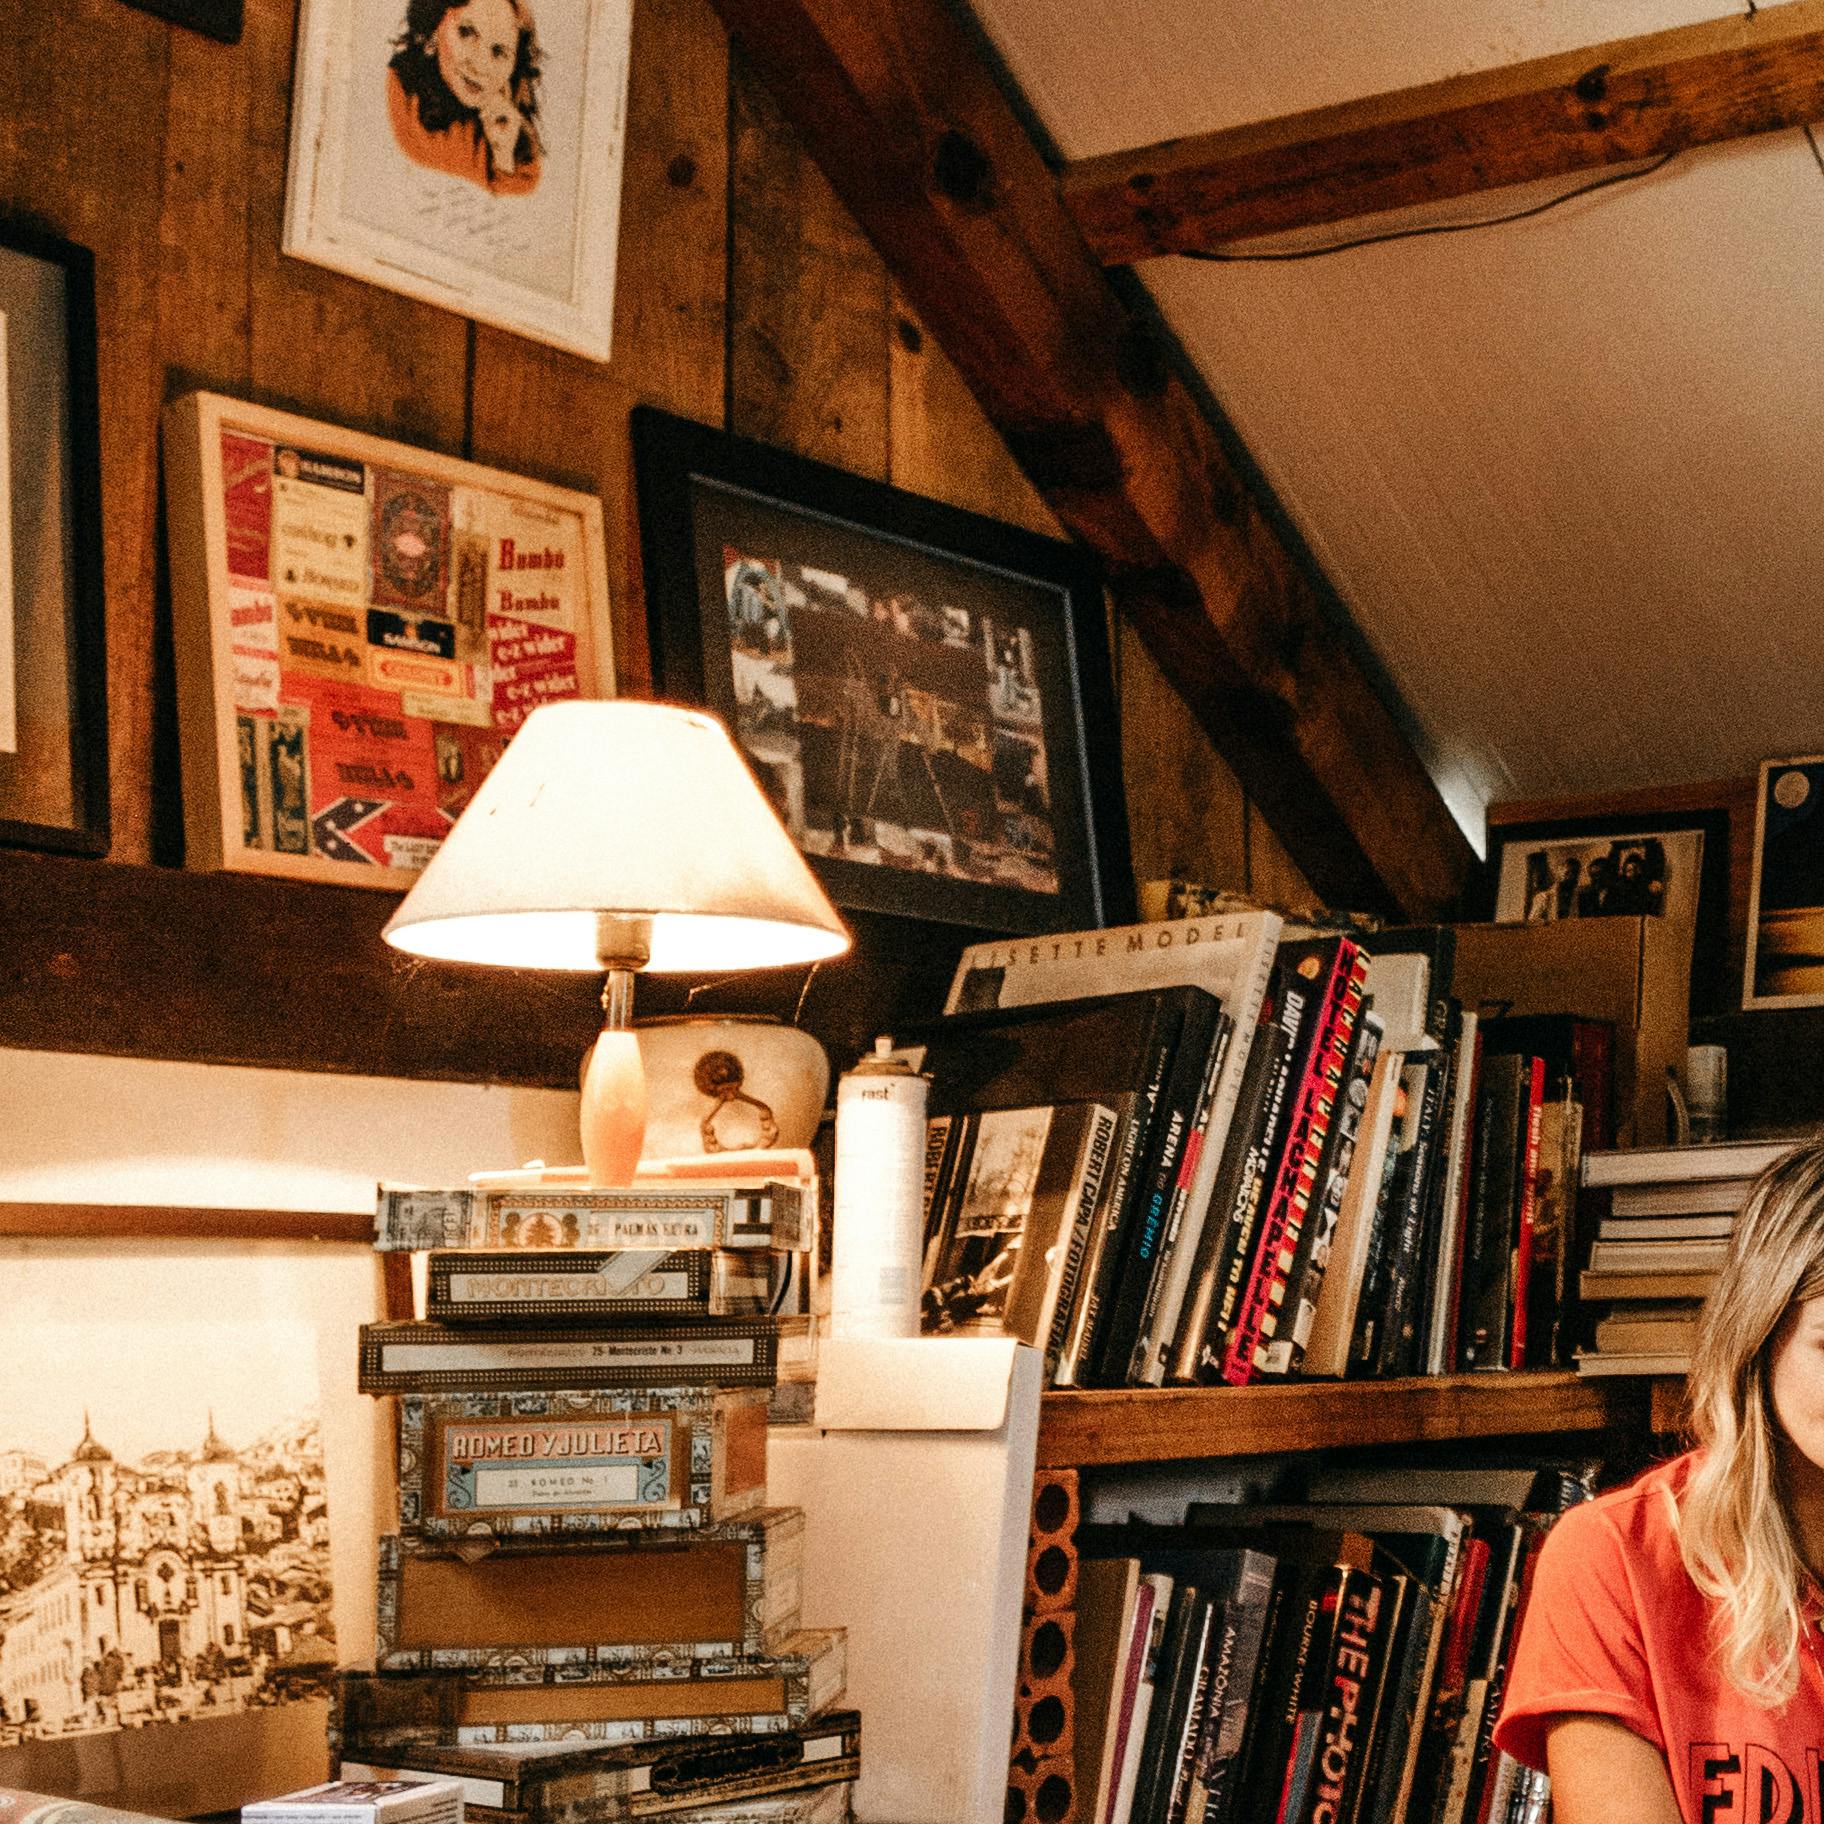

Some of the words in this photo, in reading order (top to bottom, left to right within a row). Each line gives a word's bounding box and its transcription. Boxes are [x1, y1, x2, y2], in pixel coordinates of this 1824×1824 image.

[1125, 920, 1247, 952] MODEL
[1123, 1118, 1141, 1155] LIGHT
[1159, 1109, 1185, 1168] ARENA
[1528, 1106, 1543, 1145] flesh
[1084, 1115, 1115, 1180] ROBERT
[1118, 1156, 1132, 1176] ON
[1410, 1140, 1428, 1194] Seasons
[1526, 1149, 1540, 1179] and
[1074, 1181, 1098, 1227] CAPA
[1105, 1175, 1129, 1232] AMERICA
[1136, 1191, 1166, 1260] GRÊMIO
[1399, 1216, 1417, 1253] Light
[466, 1277, 666, 1299] MONTECRITO
[1041, 1238, 1086, 1361] FOTOGRAFIAS
[453, 1434, 534, 1460] ROMEO
[556, 1430, 663, 1456] JULIETA
[531, 1477, 575, 1488] ROMEO
[1332, 1581, 1384, 1677] THE
[1208, 1625, 1238, 1719] AMAZÔNIA
